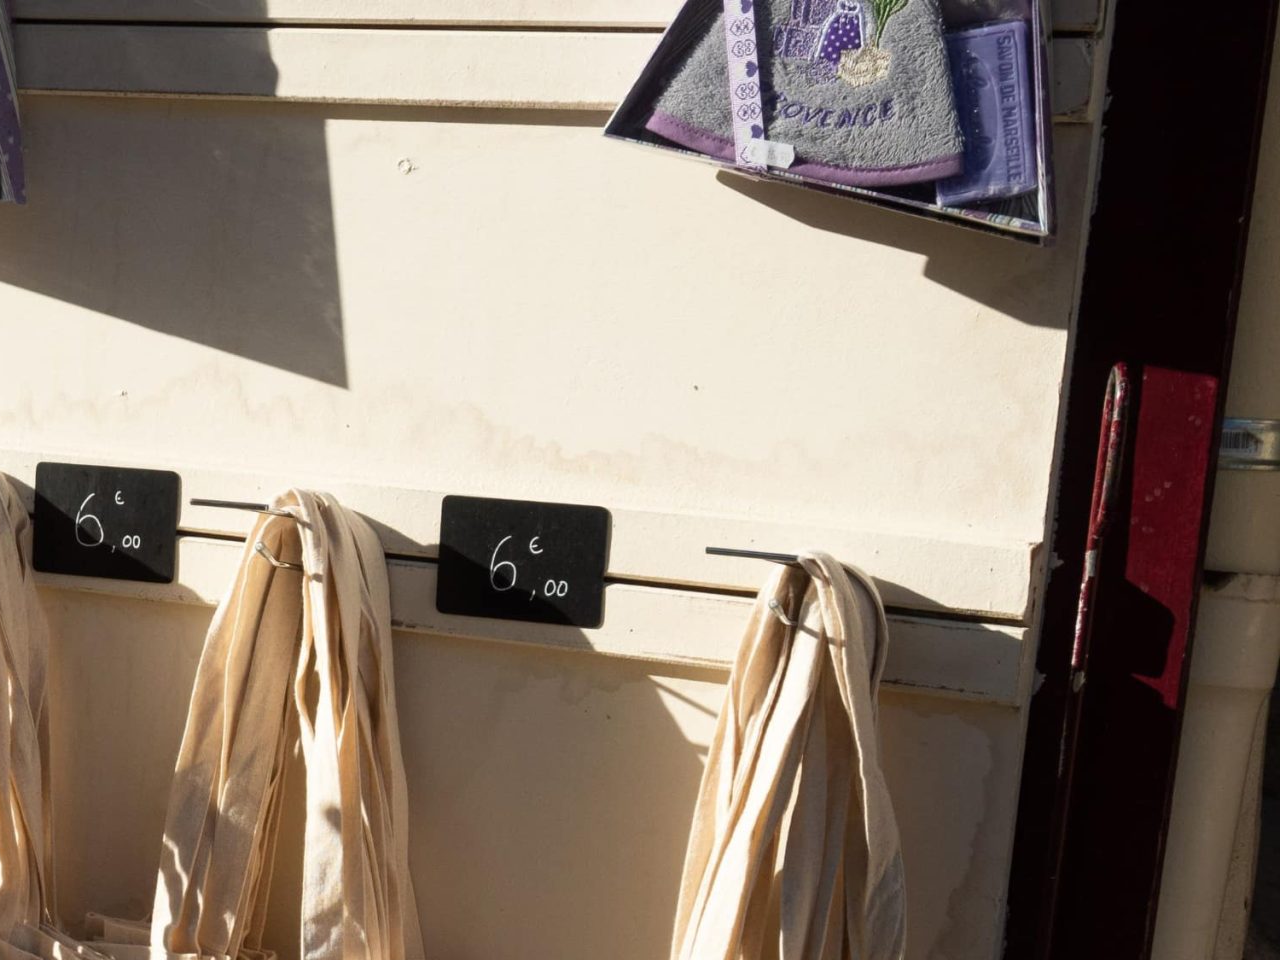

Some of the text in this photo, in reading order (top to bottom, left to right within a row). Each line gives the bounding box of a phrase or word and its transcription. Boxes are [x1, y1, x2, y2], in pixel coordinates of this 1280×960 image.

[777, 92, 895, 129] OVENCE
[997, 35, 1024, 183] SAVON DE MARSEILLE
